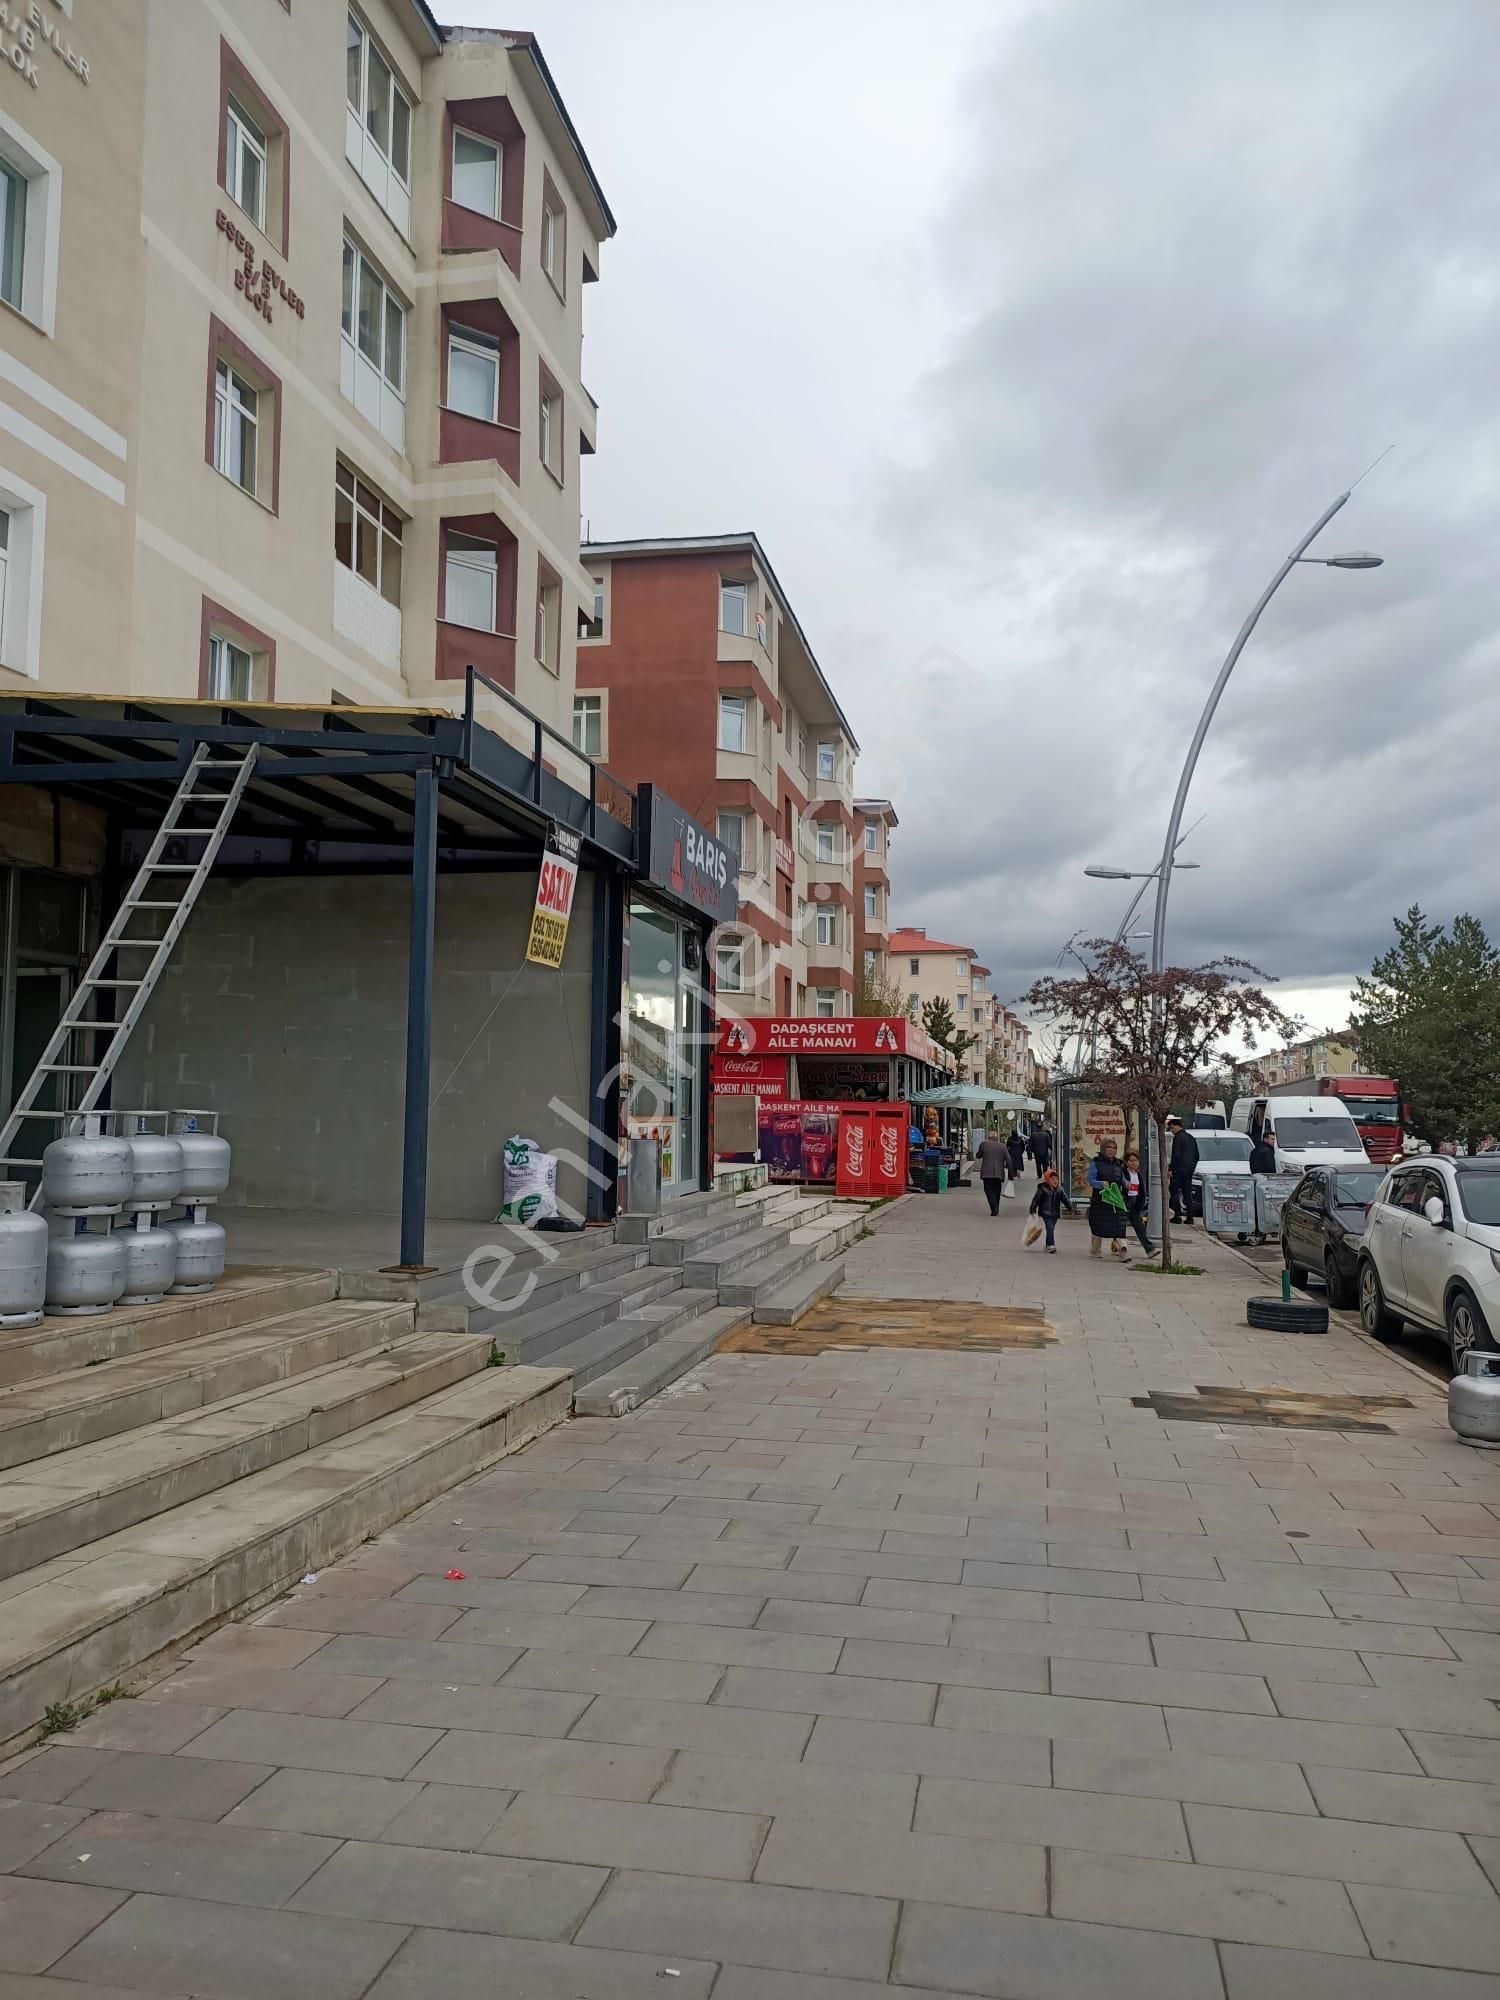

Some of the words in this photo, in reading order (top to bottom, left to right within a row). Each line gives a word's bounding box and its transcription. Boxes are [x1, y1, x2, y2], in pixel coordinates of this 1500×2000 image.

[26, 0, 91, 85] EVLER
[216, 209, 254, 263] ESER
[263, 260, 306, 319] EVLER
[235, 269, 273, 323] BLOK
[687, 824, 727, 889] BARIŞ
[768, 1037, 798, 1048] AİLE
[802, 1038, 857, 1048] MANAVI
[771, 1023, 854, 1036] DADAŞKENT
[741, 1081, 755, 1095] AİLE
[756, 1084, 781, 1095] MANAVI
[760, 1103, 801, 1112] DAŞKENT
[804, 1103, 824, 1112] AİLE
